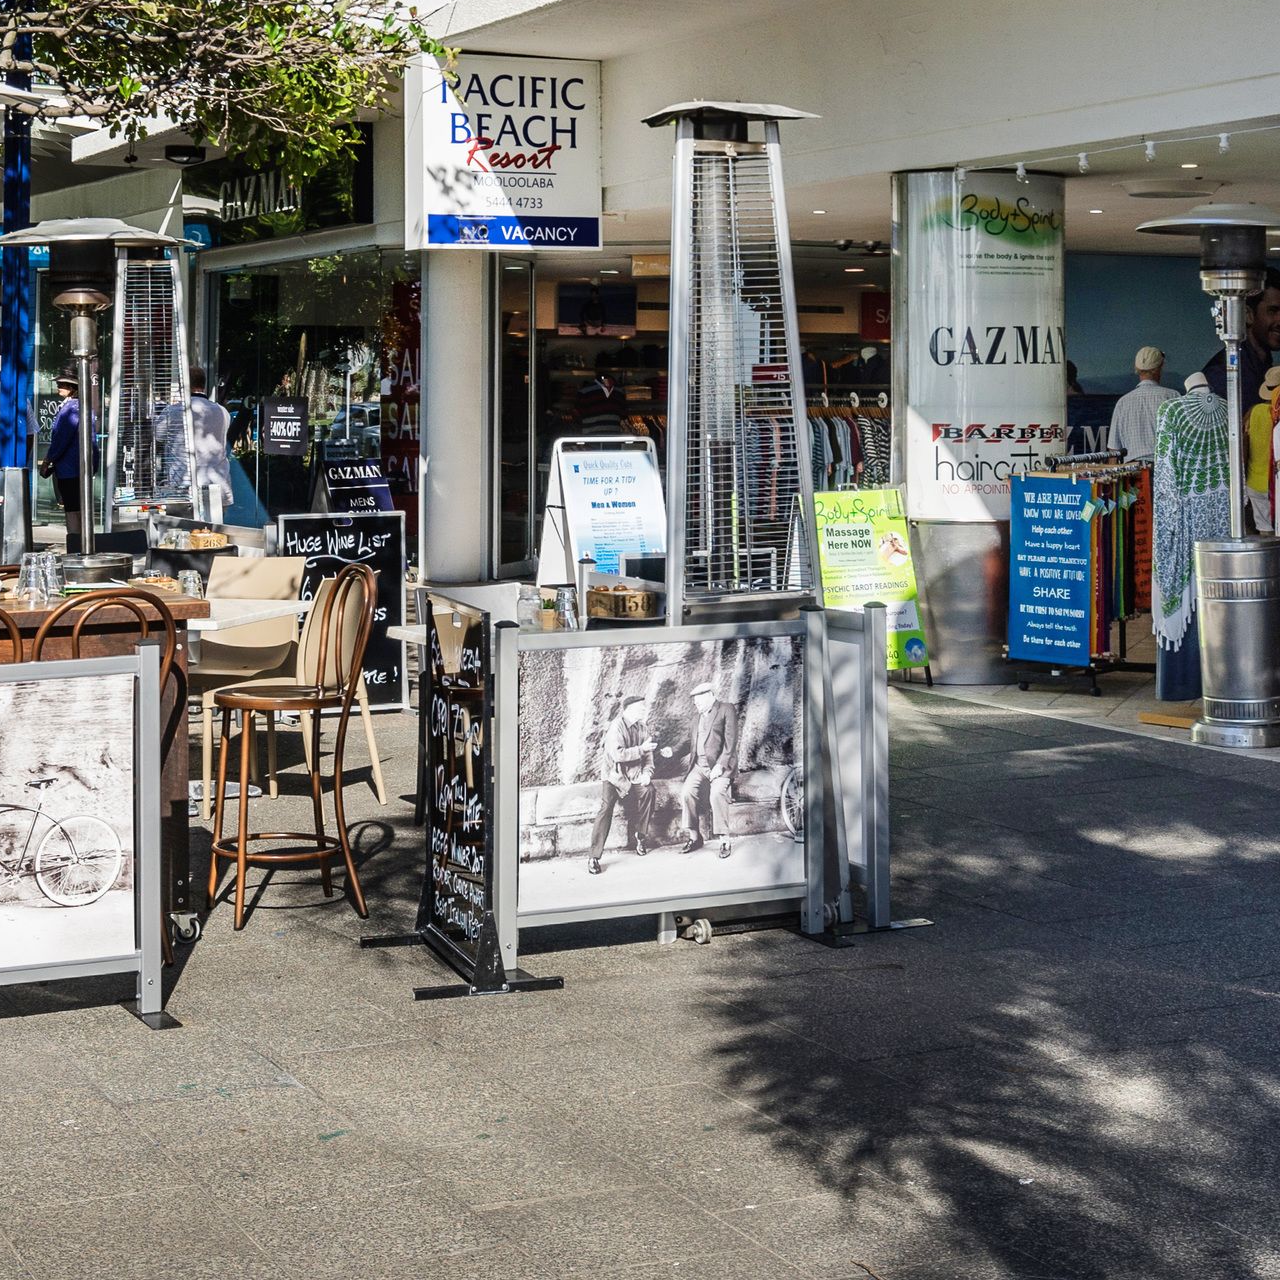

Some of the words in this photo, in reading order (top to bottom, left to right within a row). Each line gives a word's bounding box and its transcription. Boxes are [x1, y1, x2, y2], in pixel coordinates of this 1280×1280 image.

[441, 73, 586, 111] PACIFIC
[450, 112, 577, 149] BEACH
[466, 136, 562, 173] Resort
[473, 175, 554, 190] MOOLOOLABA
[515, 196, 544, 210] 4733
[502, 225, 578, 242] VACANCY
[287, 422, 301, 437] OFF
[936, 446, 1042, 481] haircuts
[328, 465, 382, 479] GAZMAN
[622, 475, 636, 484] TIDY
[604, 488, 612, 496] UP
[943, 484, 959, 494] NO
[350, 497, 375, 507] MENS
[1024, 492, 1035, 503] WE
[1037, 493, 1052, 503] ARE
[1053, 494, 1081, 505] FAMILY
[1024, 508, 1039, 518] KNOW
[1042, 509, 1052, 519] YOU
[1055, 509, 1063, 519] ARE
[826, 528, 870, 538] Massage
[1032, 525, 1043, 536] Help
[1045, 526, 1056, 534] each
[287, 531, 322, 555] HUGE
[326, 530, 355, 555] WINE
[358, 532, 392, 554] LIST
[828, 541, 849, 549] Here
[851, 540, 871, 548] NOW
[1046, 541, 1063, 551] happy
[1065, 542, 1080, 550] heart
[1034, 567, 1038, 577] A
[1040, 568, 1061, 579] POSITIVE
[824, 585, 850, 593] PSYCHIC
[875, 581, 908, 589] READINGS
[1033, 587, 1070, 599] SHARE
[1027, 621, 1044, 629] Always
[1023, 635, 1030, 643] Be
[1045, 637, 1053, 645] for
[1067, 640, 1081, 648] other
